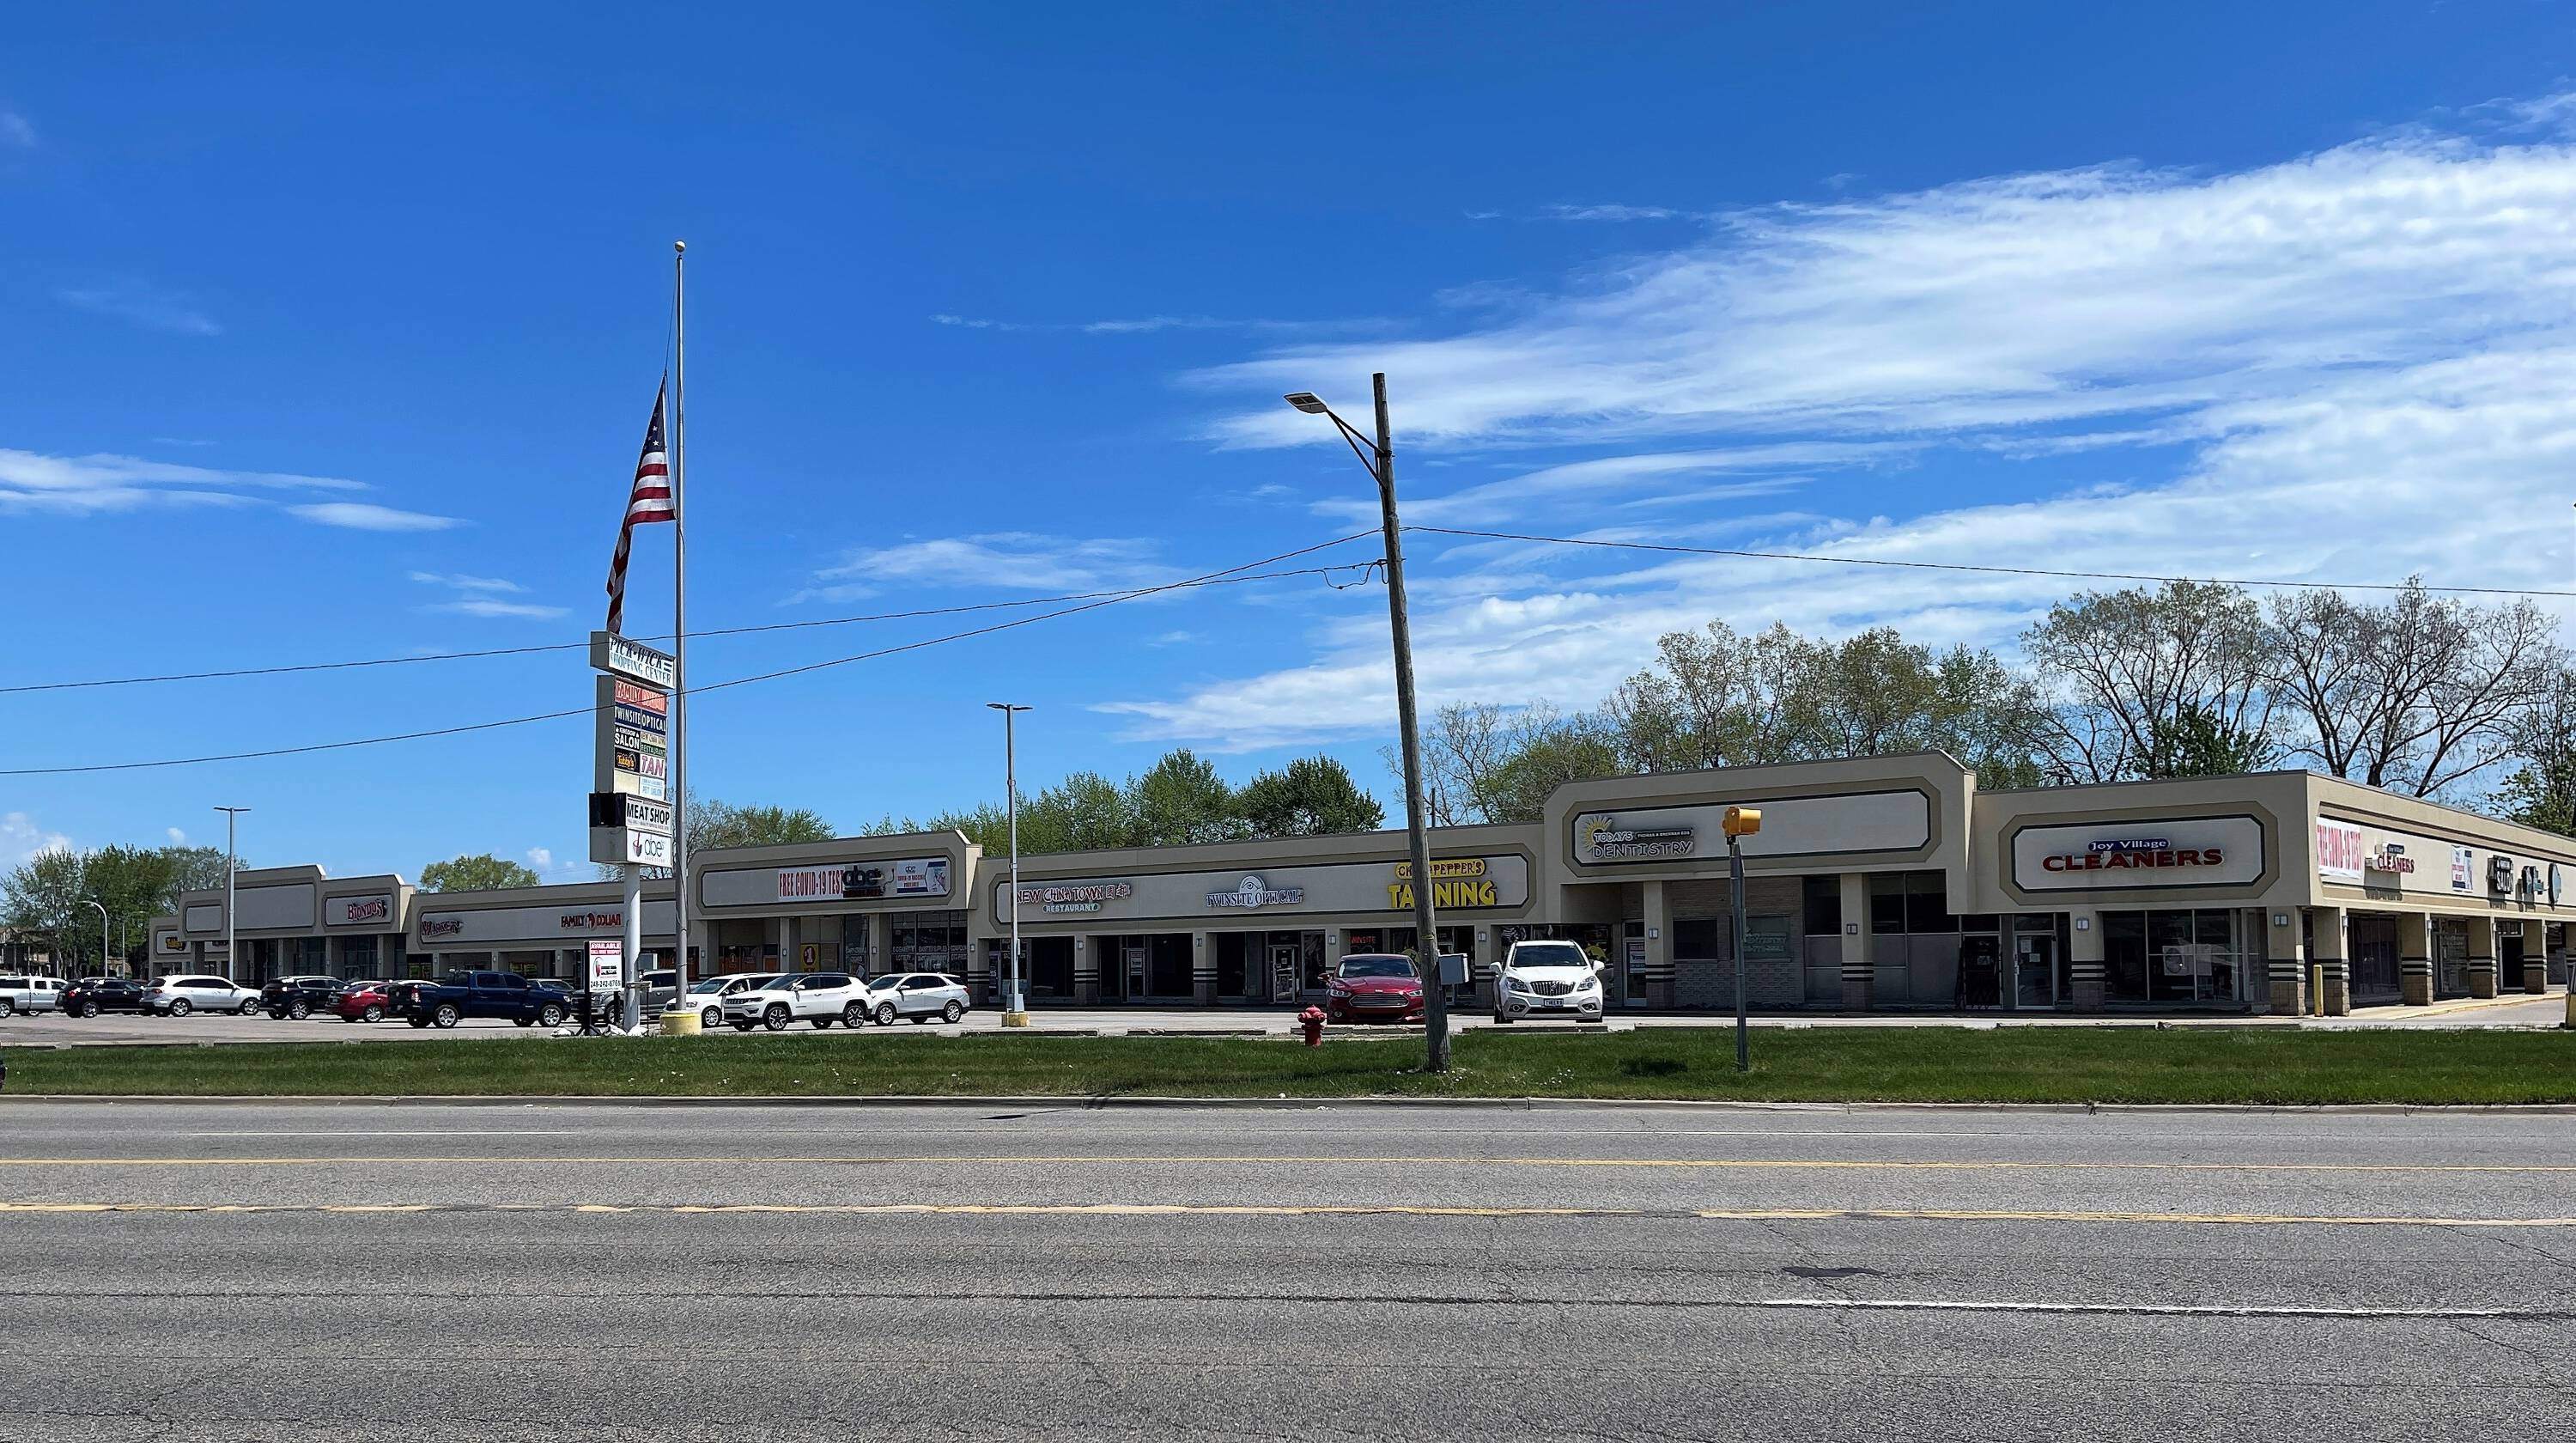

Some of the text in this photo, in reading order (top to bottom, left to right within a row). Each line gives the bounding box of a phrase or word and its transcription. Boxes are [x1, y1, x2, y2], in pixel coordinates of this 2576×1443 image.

[611, 652, 671, 685] SHOPPING CENTER
[616, 681, 641, 703] FAMILY
[615, 706, 666, 732] TWINSITE OPTICAL
[615, 733, 640, 750] SALON
[641, 756, 665, 777] TAN
[627, 803, 648, 821] MEAT
[650, 808, 670, 825] SHOP
[1593, 841, 1693, 859] DENTISTRY
[2091, 840, 2167, 850] Joy Village
[2042, 849, 2224, 872] CLEANERS
[2377, 854, 2415, 874] CLEANERS
[779, 873, 794, 897] FREE
[795, 871, 826, 896] COVID-19
[1388, 880, 1498, 908] TANING
[1016, 889, 1042, 903] NEW
[1206, 890, 1300, 907] TWINSITE OPTICAL
[1047, 903, 1096, 912] RESTAURANT
[561, 913, 622, 928] FAMILY DOLLAR
